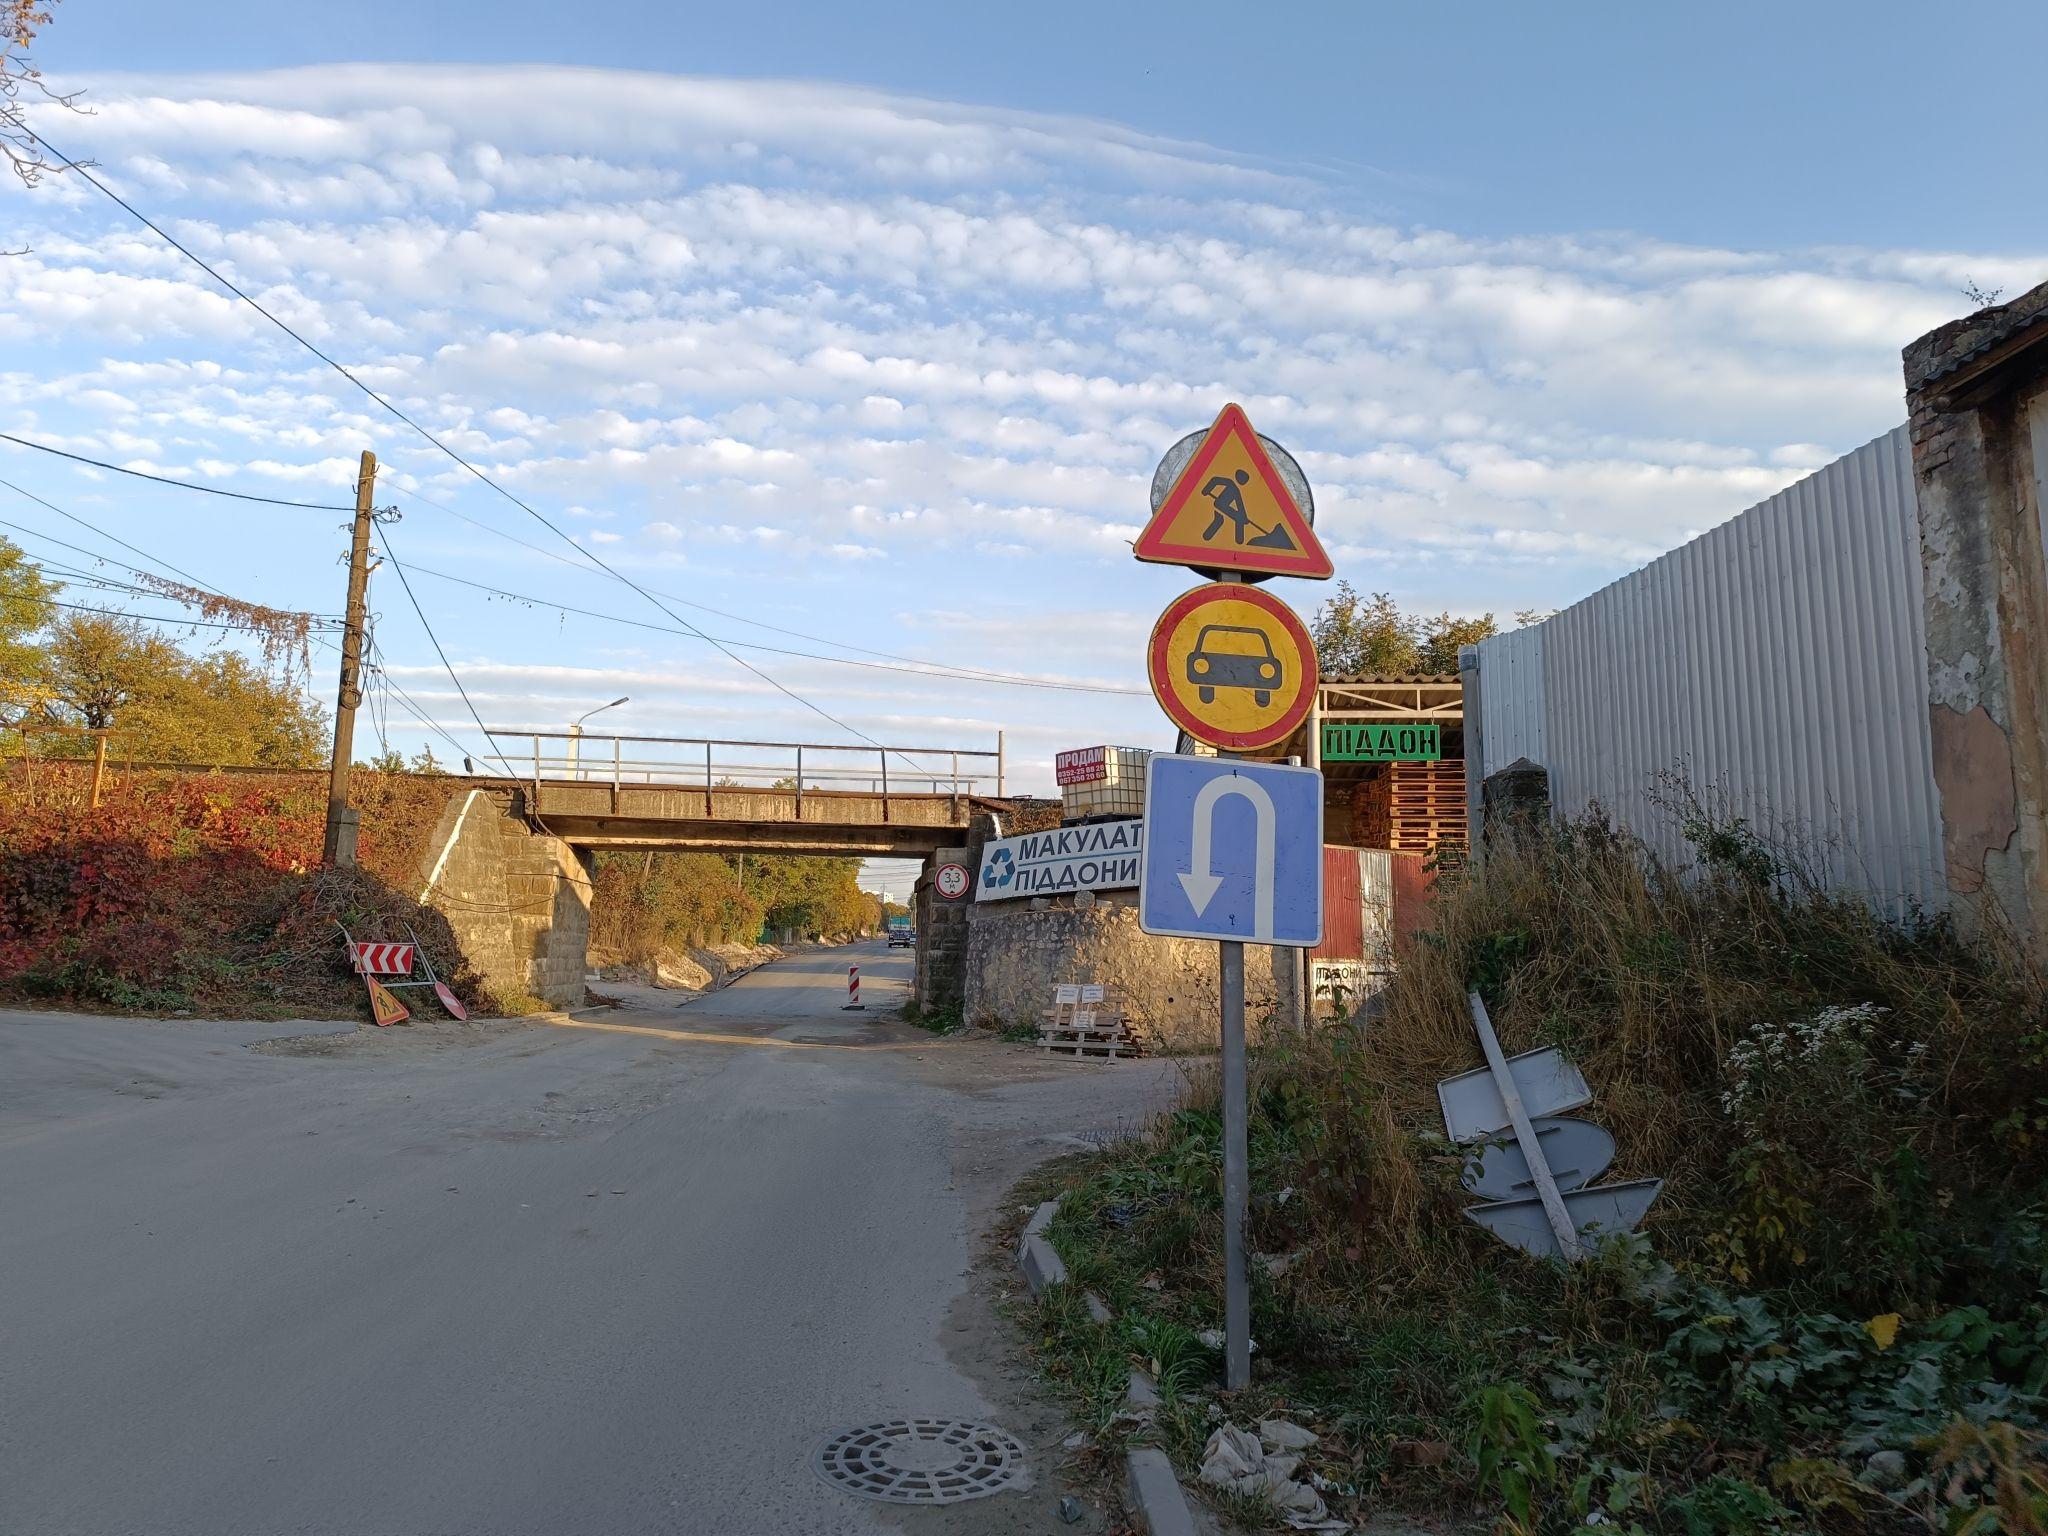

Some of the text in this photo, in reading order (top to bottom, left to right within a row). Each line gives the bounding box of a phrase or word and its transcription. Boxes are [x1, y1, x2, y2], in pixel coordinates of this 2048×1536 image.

[1326, 729, 1436, 757] ПІДДОН
[1057, 748, 1104, 769] ПРОДАМ
[1018, 823, 1143, 860] МАКУЛАТ
[944, 872, 960, 884] 3,3
[1014, 859, 1136, 891] ПІДДОНИ
